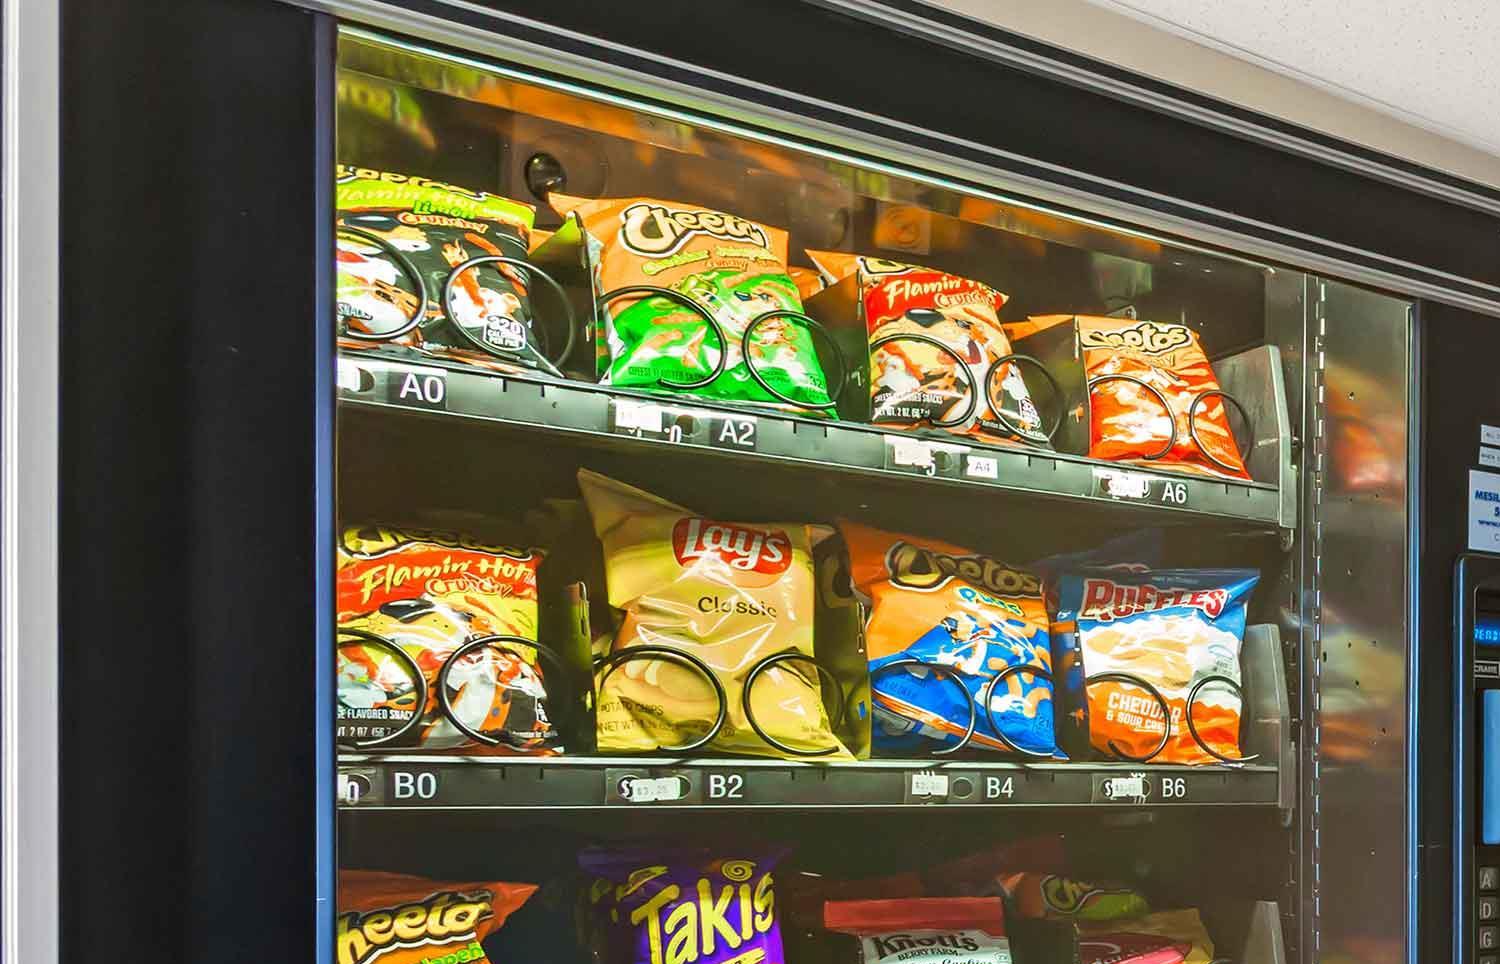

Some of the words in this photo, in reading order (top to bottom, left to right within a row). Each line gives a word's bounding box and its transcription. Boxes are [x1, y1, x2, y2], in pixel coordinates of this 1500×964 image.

[399, 371, 445, 403] A0
[719, 419, 755, 446] A2
[1161, 481, 1188, 504] A6
[681, 519, 786, 571] Lay's
[477, 556, 531, 581] Hot
[697, 595, 777, 618] Classic
[1081, 579, 1227, 621] RUFFLES
[348, 709, 388, 720] FLAVORED
[389, 710, 414, 721] SNAC
[1117, 711, 1143, 728] SOUR
[1144, 718, 1179, 736] CREM
[394, 771, 438, 799] B0
[709, 774, 744, 799] B2
[986, 776, 1014, 799] B4
[1162, 777, 1186, 798] B6
[873, 931, 980, 961] Knott's
[897, 949, 929, 961] BERRY
